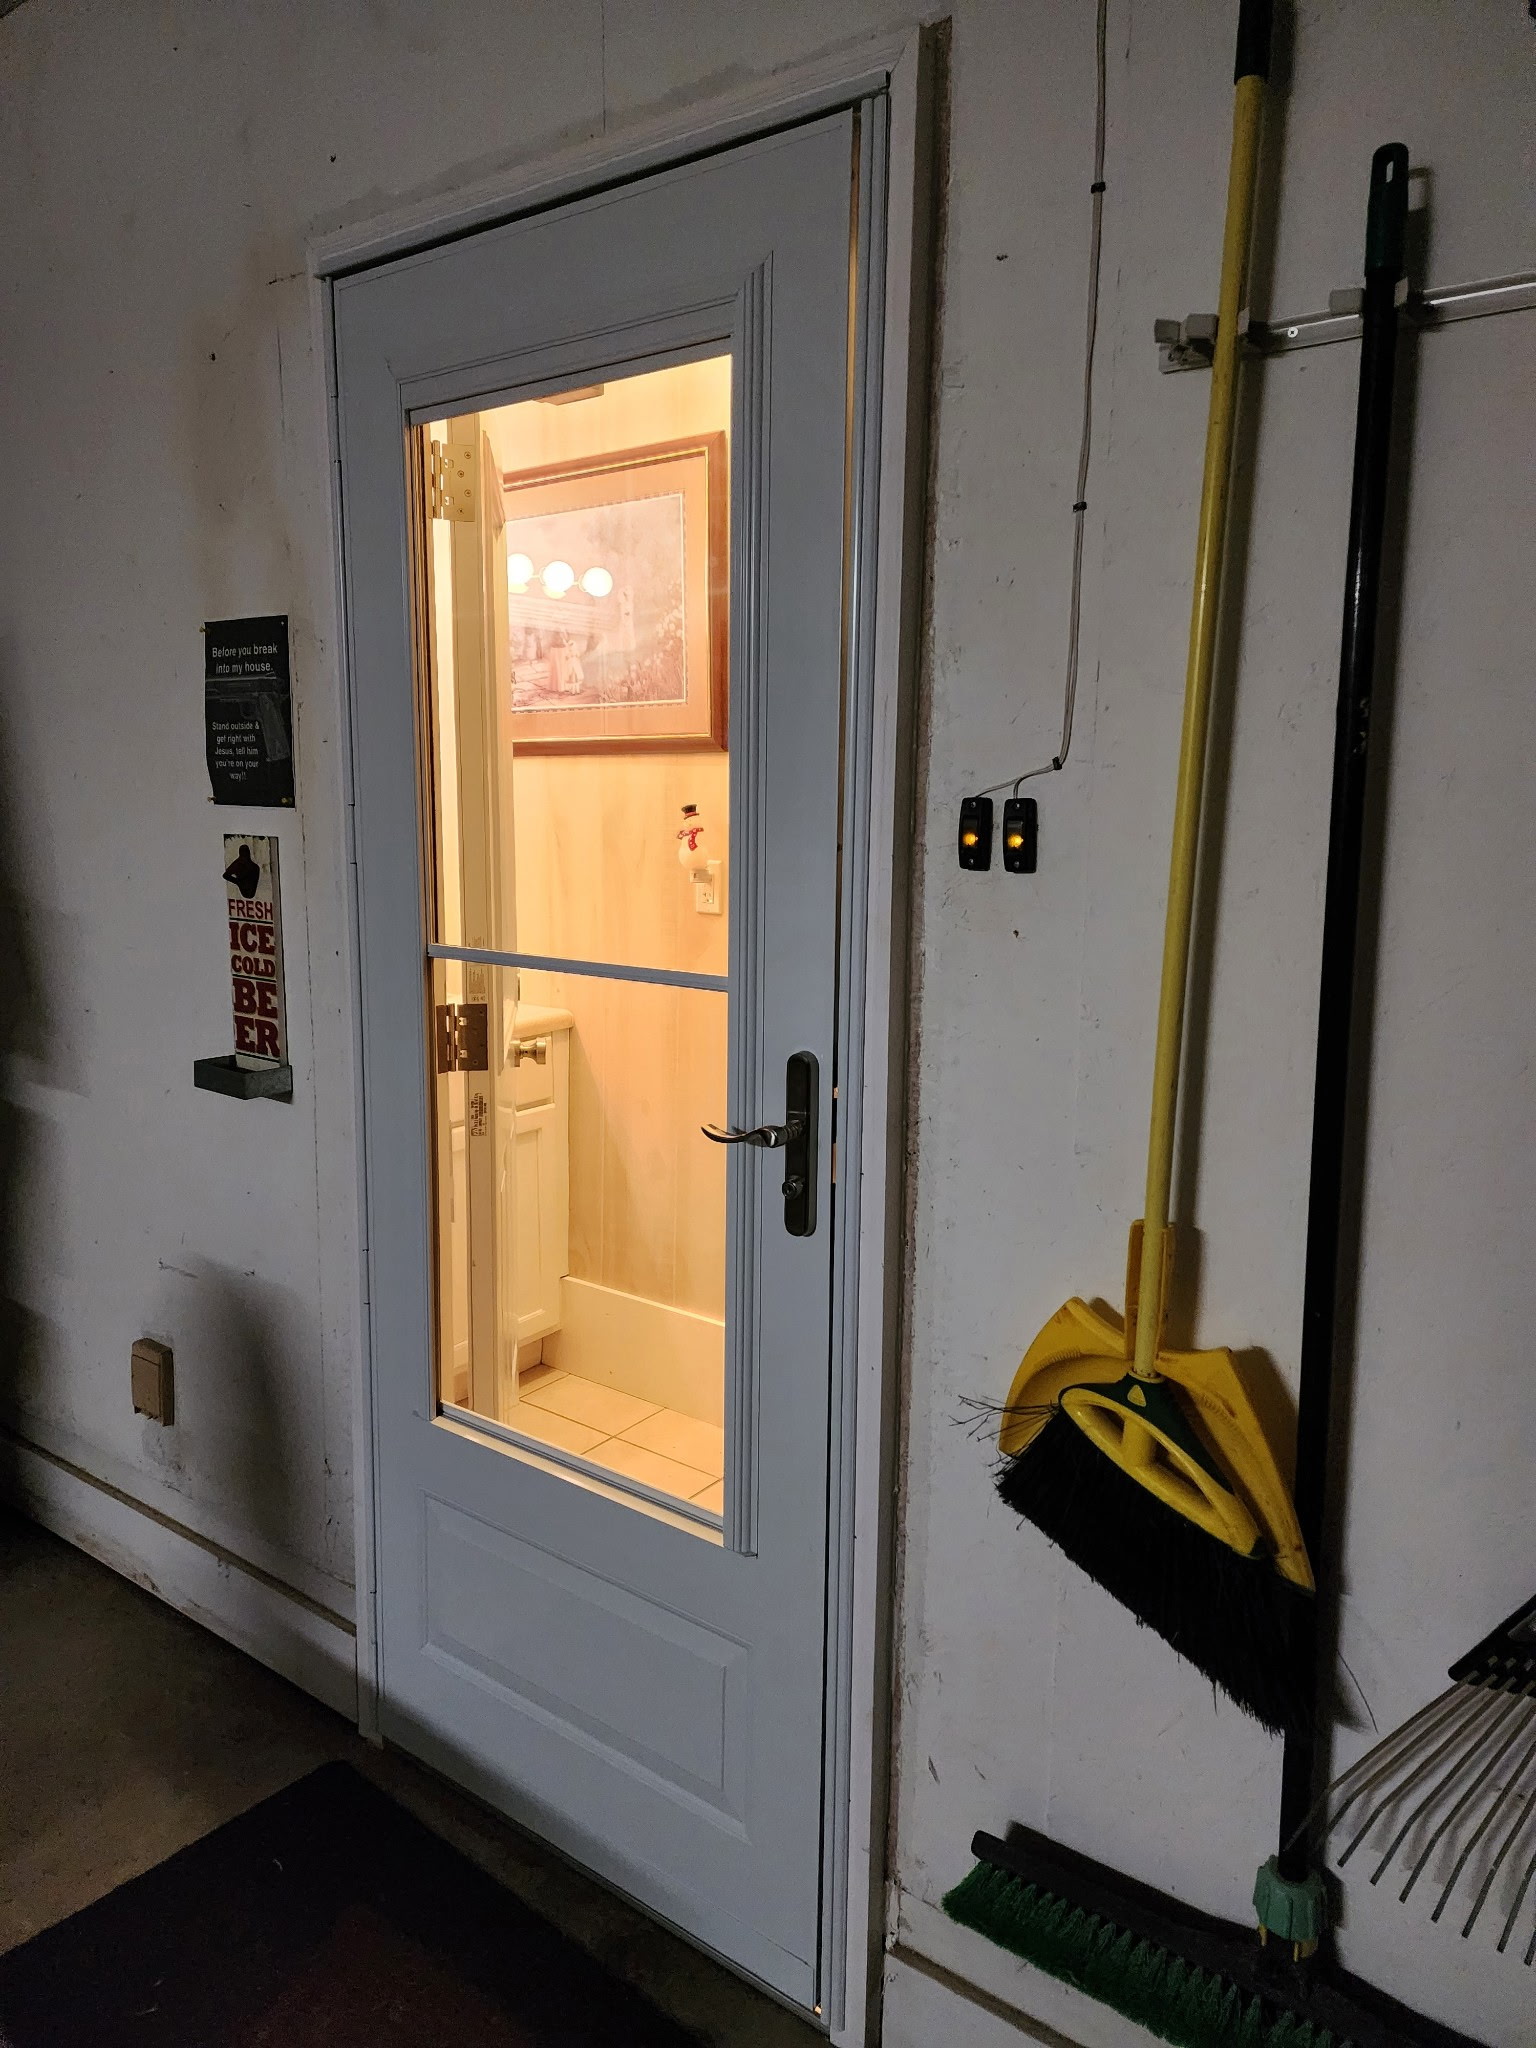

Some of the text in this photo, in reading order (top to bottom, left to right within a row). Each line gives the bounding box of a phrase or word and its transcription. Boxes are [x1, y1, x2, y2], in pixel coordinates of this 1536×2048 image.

[212, 642, 278, 658] Before you break
[215, 661, 273, 675] into my house.
[212, 720, 260, 731] Stand outside &
[216, 734, 226, 745] get
[242, 733, 256, 742] with
[246, 746, 259, 755] him
[228, 899, 273, 920] FRESH
[229, 922, 275, 955] ICE
[231, 955, 275, 977] COLD
